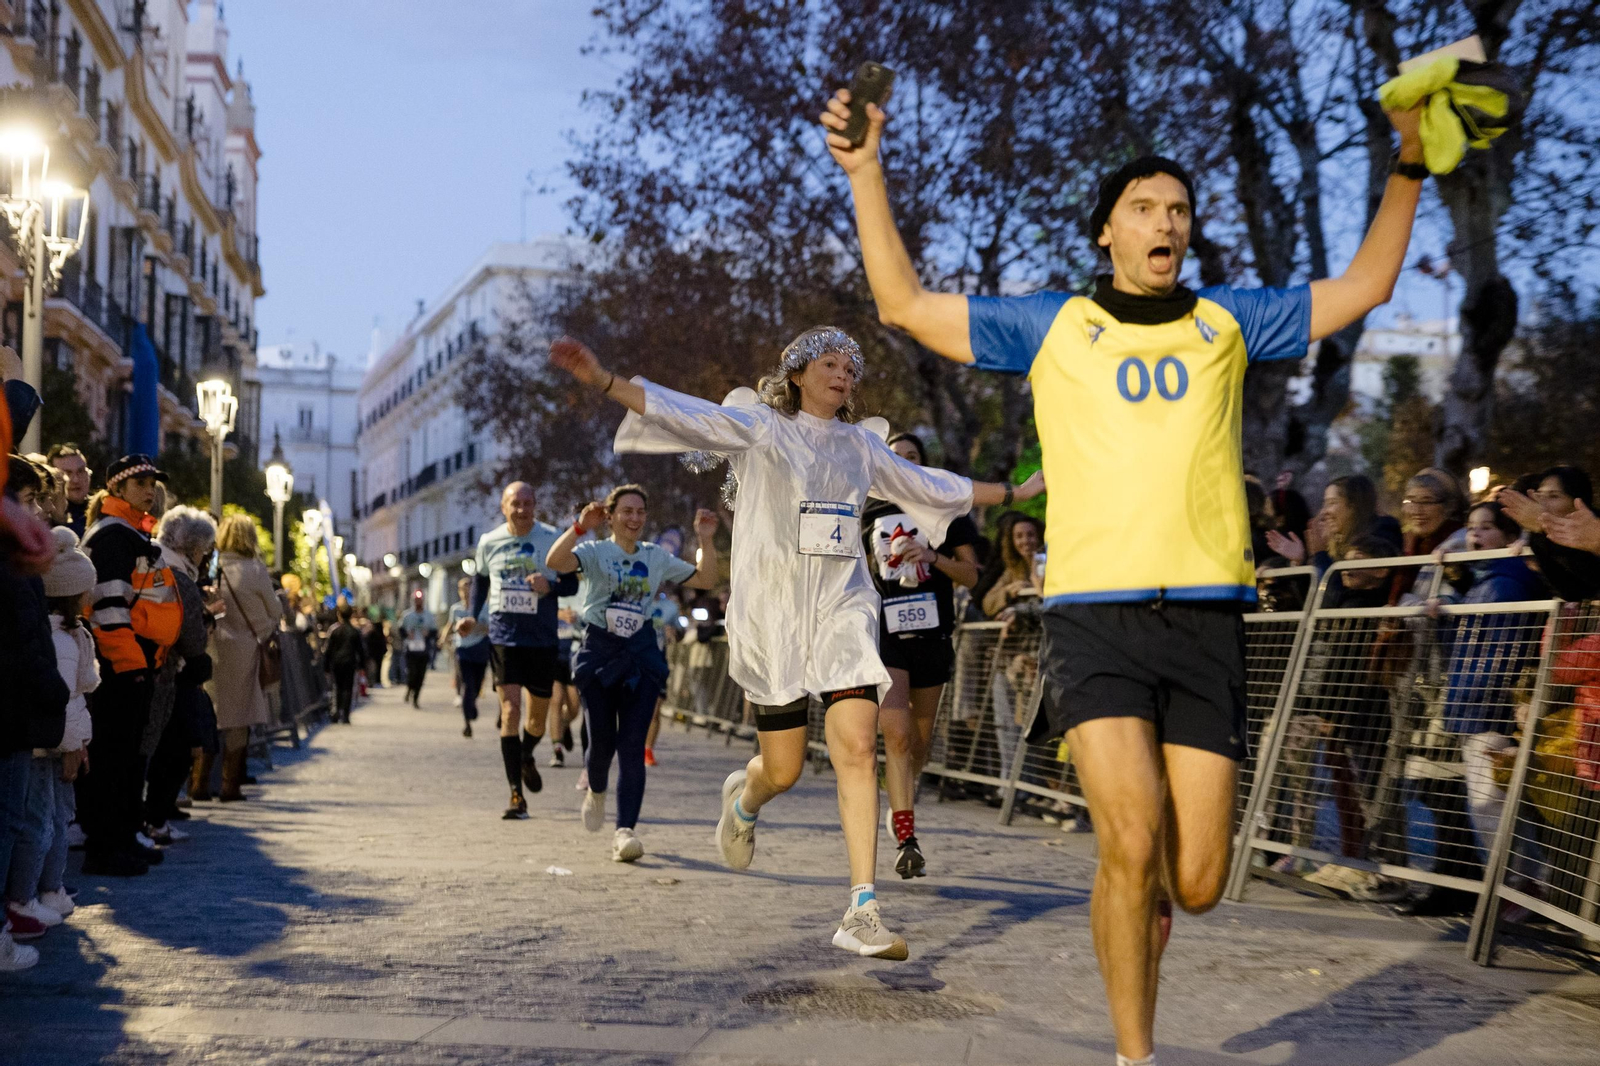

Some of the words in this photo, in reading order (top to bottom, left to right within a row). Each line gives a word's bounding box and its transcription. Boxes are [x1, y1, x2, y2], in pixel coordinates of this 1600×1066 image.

[1116, 355, 1188, 403] 00
[830, 524, 842, 544] 4
[505, 596, 532, 606] 1034
[898, 607, 926, 623] 559
[615, 616, 638, 631] 558
